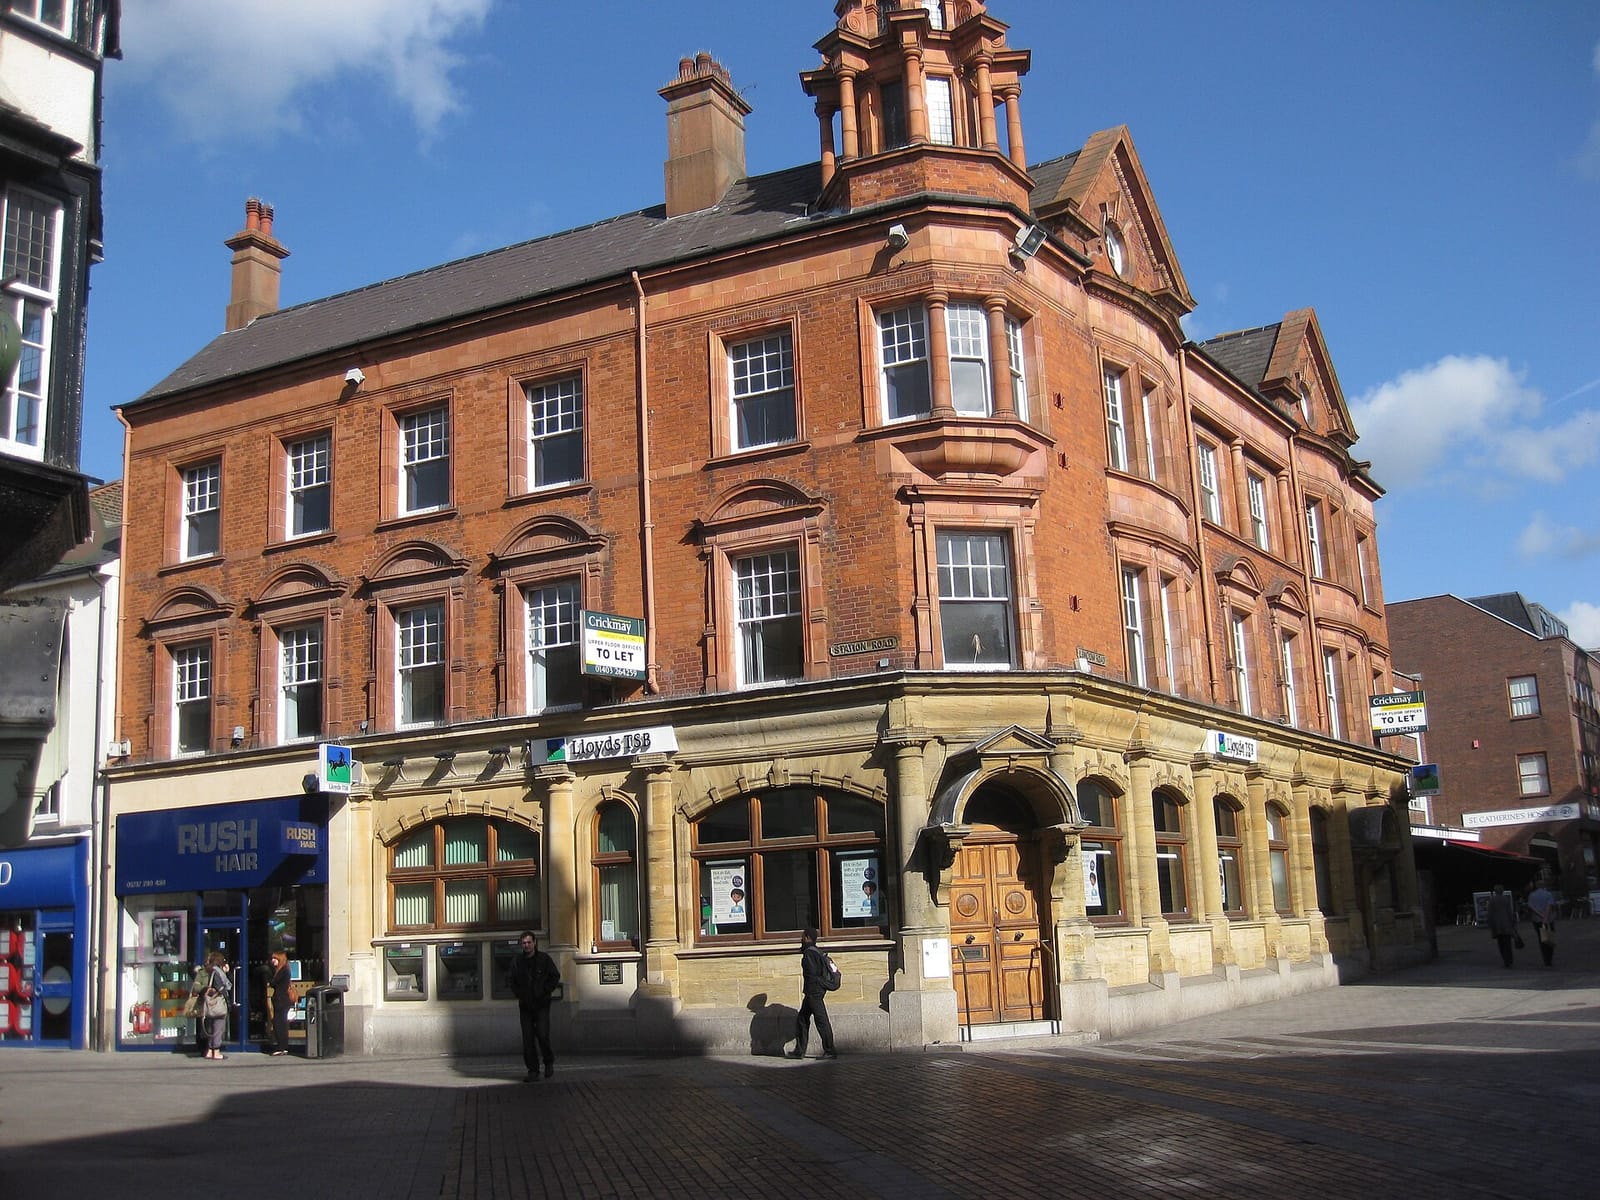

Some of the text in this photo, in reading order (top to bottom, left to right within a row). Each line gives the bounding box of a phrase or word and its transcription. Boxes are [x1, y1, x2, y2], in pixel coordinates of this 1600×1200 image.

[588, 615, 632, 634] Crickmay
[622, 644, 642, 652] OFFICES
[834, 638, 894, 655] STATION ROAD
[596, 648, 634, 662] TO LET
[595, 665, 613, 675] 01403
[1372, 695, 1412, 706] Crickmay
[1397, 715, 1416, 723] LET
[571, 732, 652, 757] Lloyds TSB
[1527, 809, 1557, 820] HOSPICE
[177, 818, 258, 855] RUSH
[286, 827, 316, 841] RUSH
[300, 840, 316, 849] HAIR
[215, 852, 258, 873] HAIR
